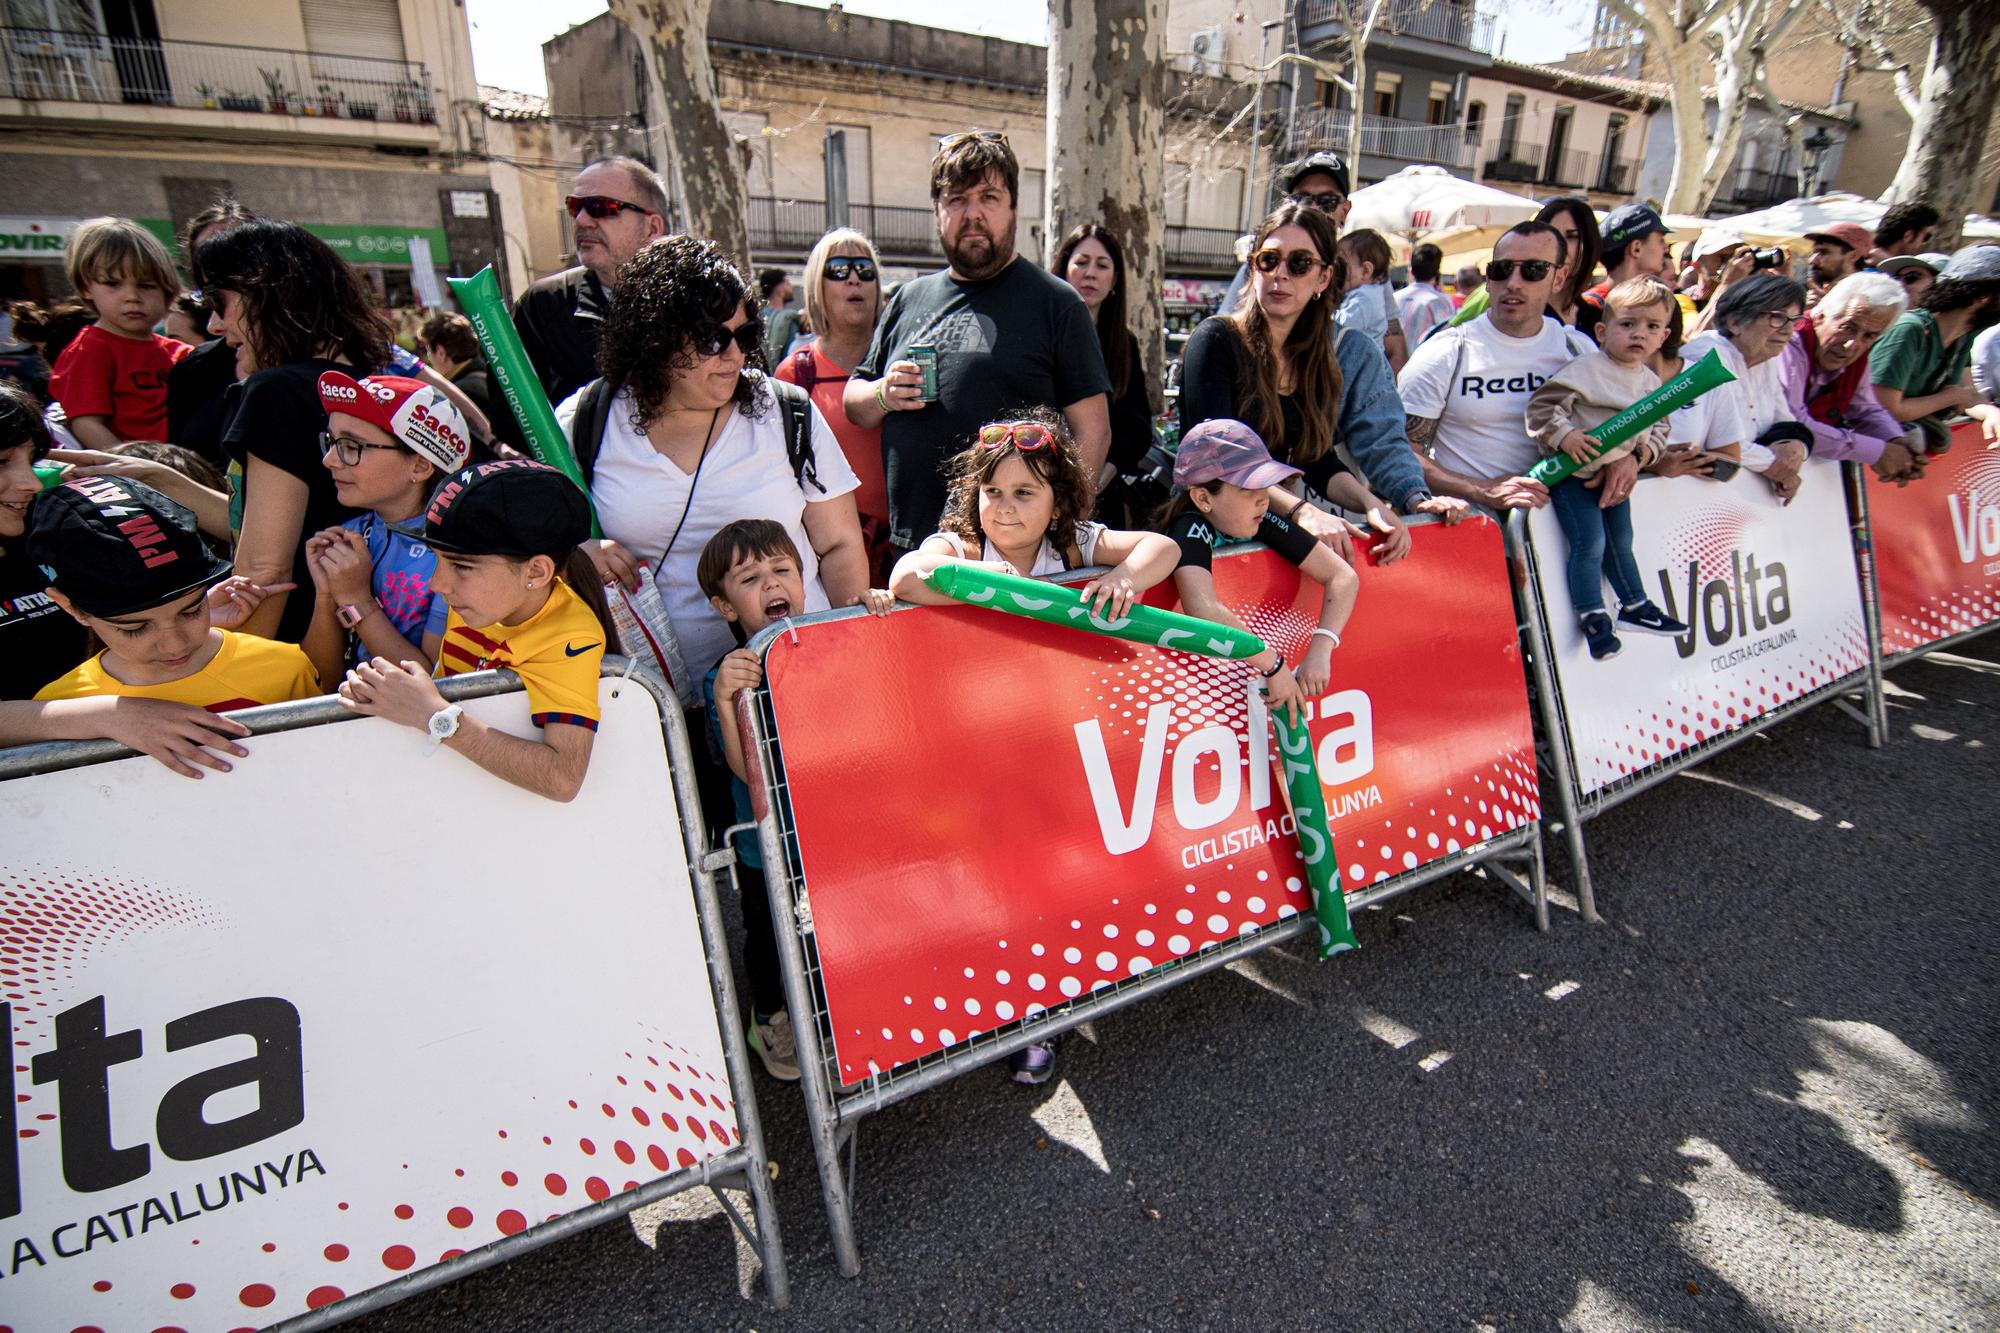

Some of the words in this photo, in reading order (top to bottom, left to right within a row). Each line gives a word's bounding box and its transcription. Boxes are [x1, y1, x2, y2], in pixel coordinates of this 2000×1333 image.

[471, 312, 499, 364] veritat
[320, 381, 358, 399] Saeco
[496, 365, 511, 386] de
[1638, 402, 1654, 416] de
[1654, 377, 1693, 405] veritat
[410, 404, 466, 454] Saeco
[1271, 515, 1290, 533] VELO
[1658, 549, 1792, 659] Volta
[1074, 678, 1374, 855] Vola
[1181, 825, 1264, 869] CICLISTA
[1265, 819, 1280, 842] A
[11, 1235, 47, 1276] A
[52, 1148, 327, 1259] CATALUNYA
